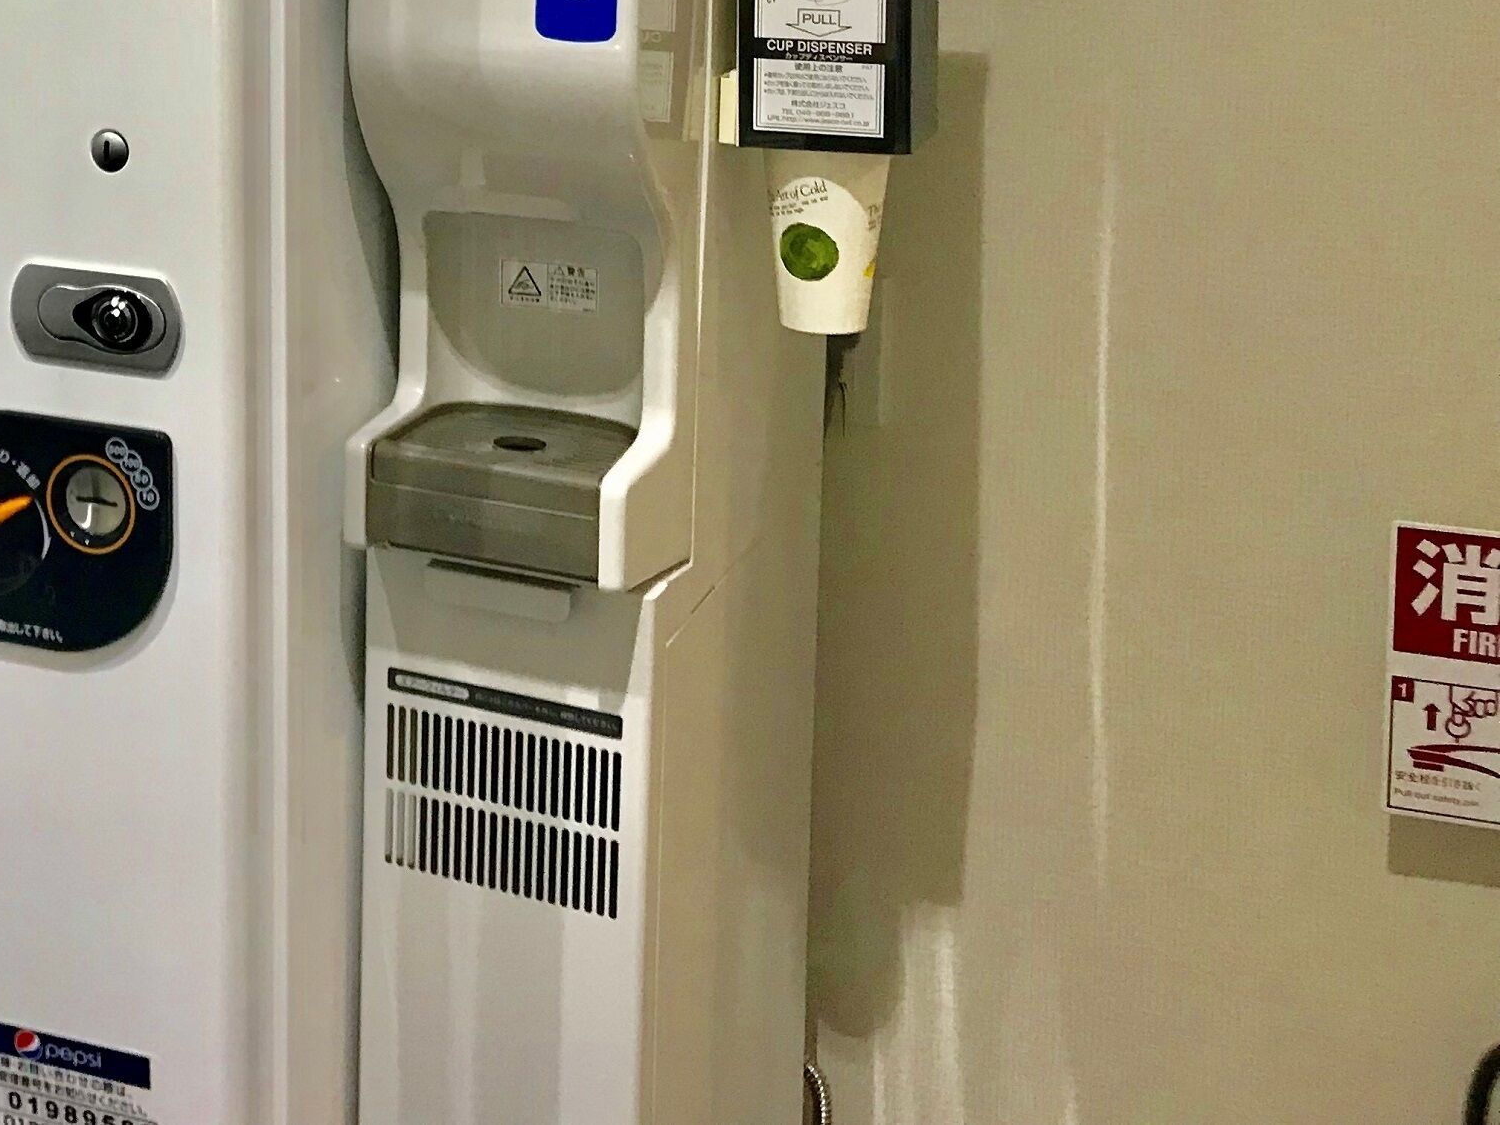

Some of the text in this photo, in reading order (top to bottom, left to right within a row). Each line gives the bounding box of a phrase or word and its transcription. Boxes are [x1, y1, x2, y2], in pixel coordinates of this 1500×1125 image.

[802, 13, 837, 25] PULL
[766, 39, 873, 56] CUP DISPENSER
[799, 179, 828, 197] Cold
[1410, 538, 1500, 626] 消
[1453, 627, 1500, 659] FIR
[1397, 681, 1408, 699] 1
[45, 1042, 102, 1068] pepsi
